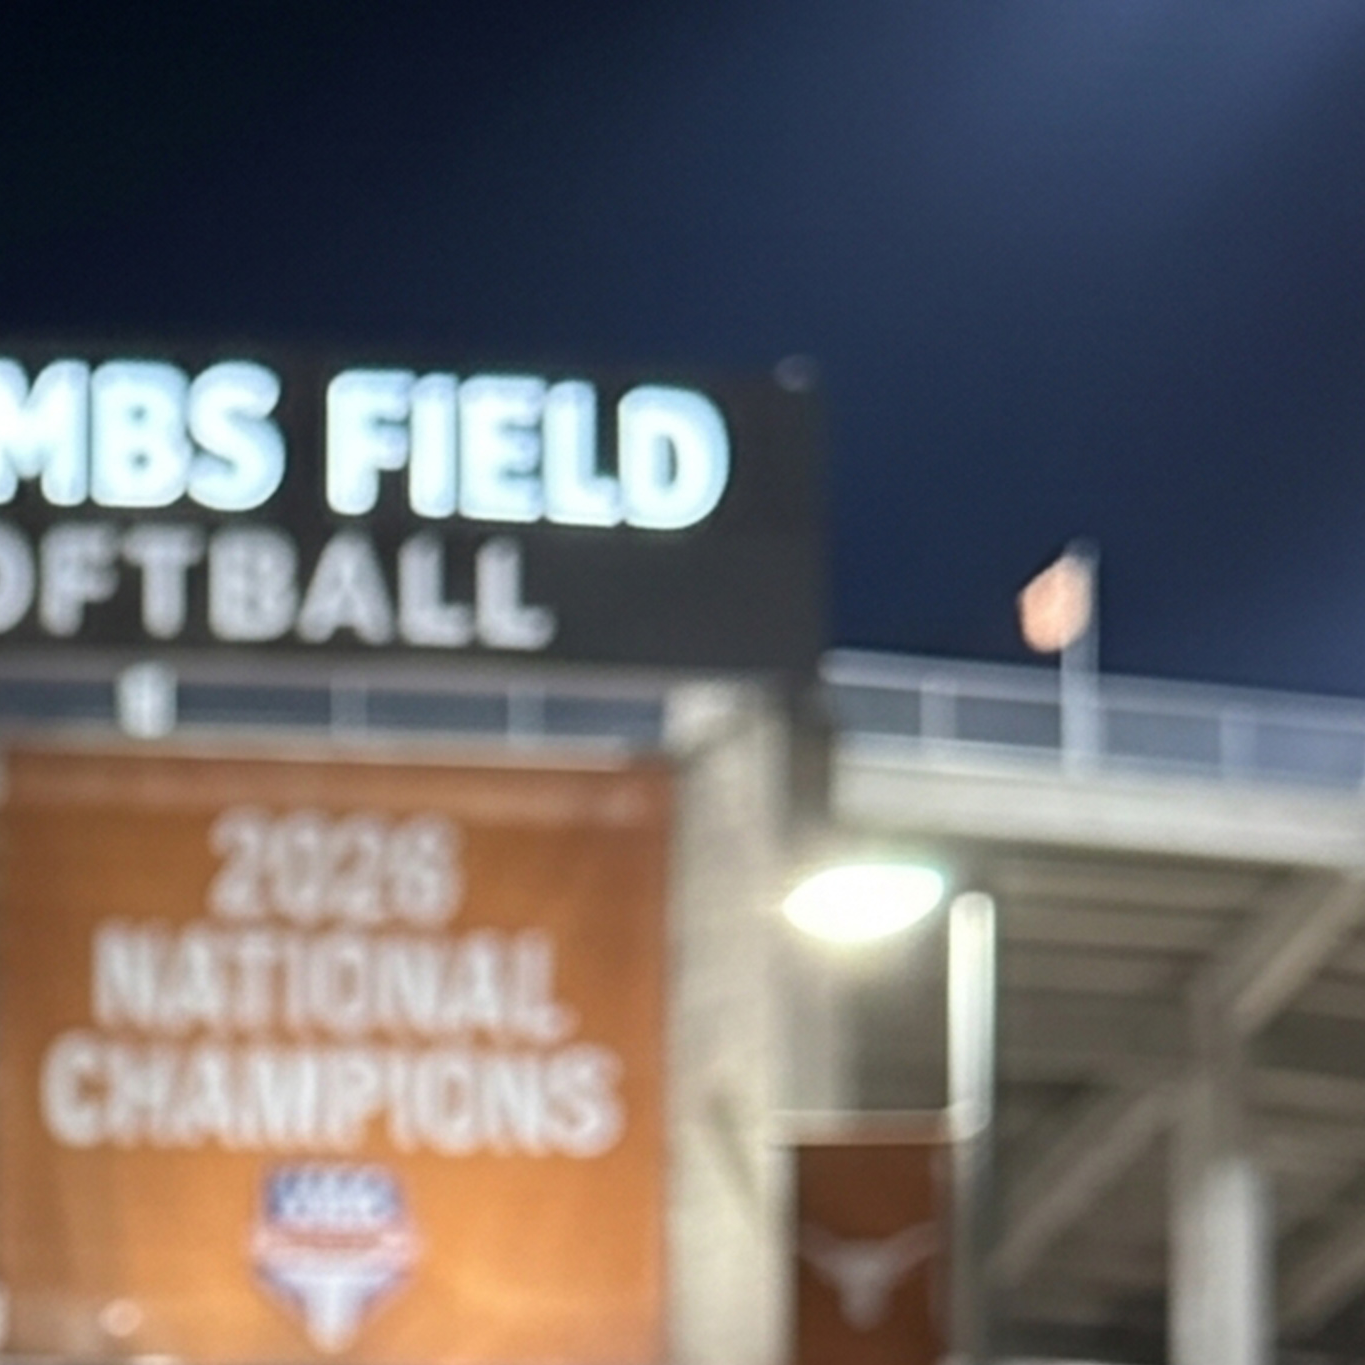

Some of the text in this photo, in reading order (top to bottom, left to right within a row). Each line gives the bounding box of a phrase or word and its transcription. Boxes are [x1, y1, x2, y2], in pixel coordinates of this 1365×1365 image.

[325, 369, 730, 530] FIELD
[91, 918, 579, 1043] NATIONAL
[40, 1029, 627, 1159] CHAMPIONS
